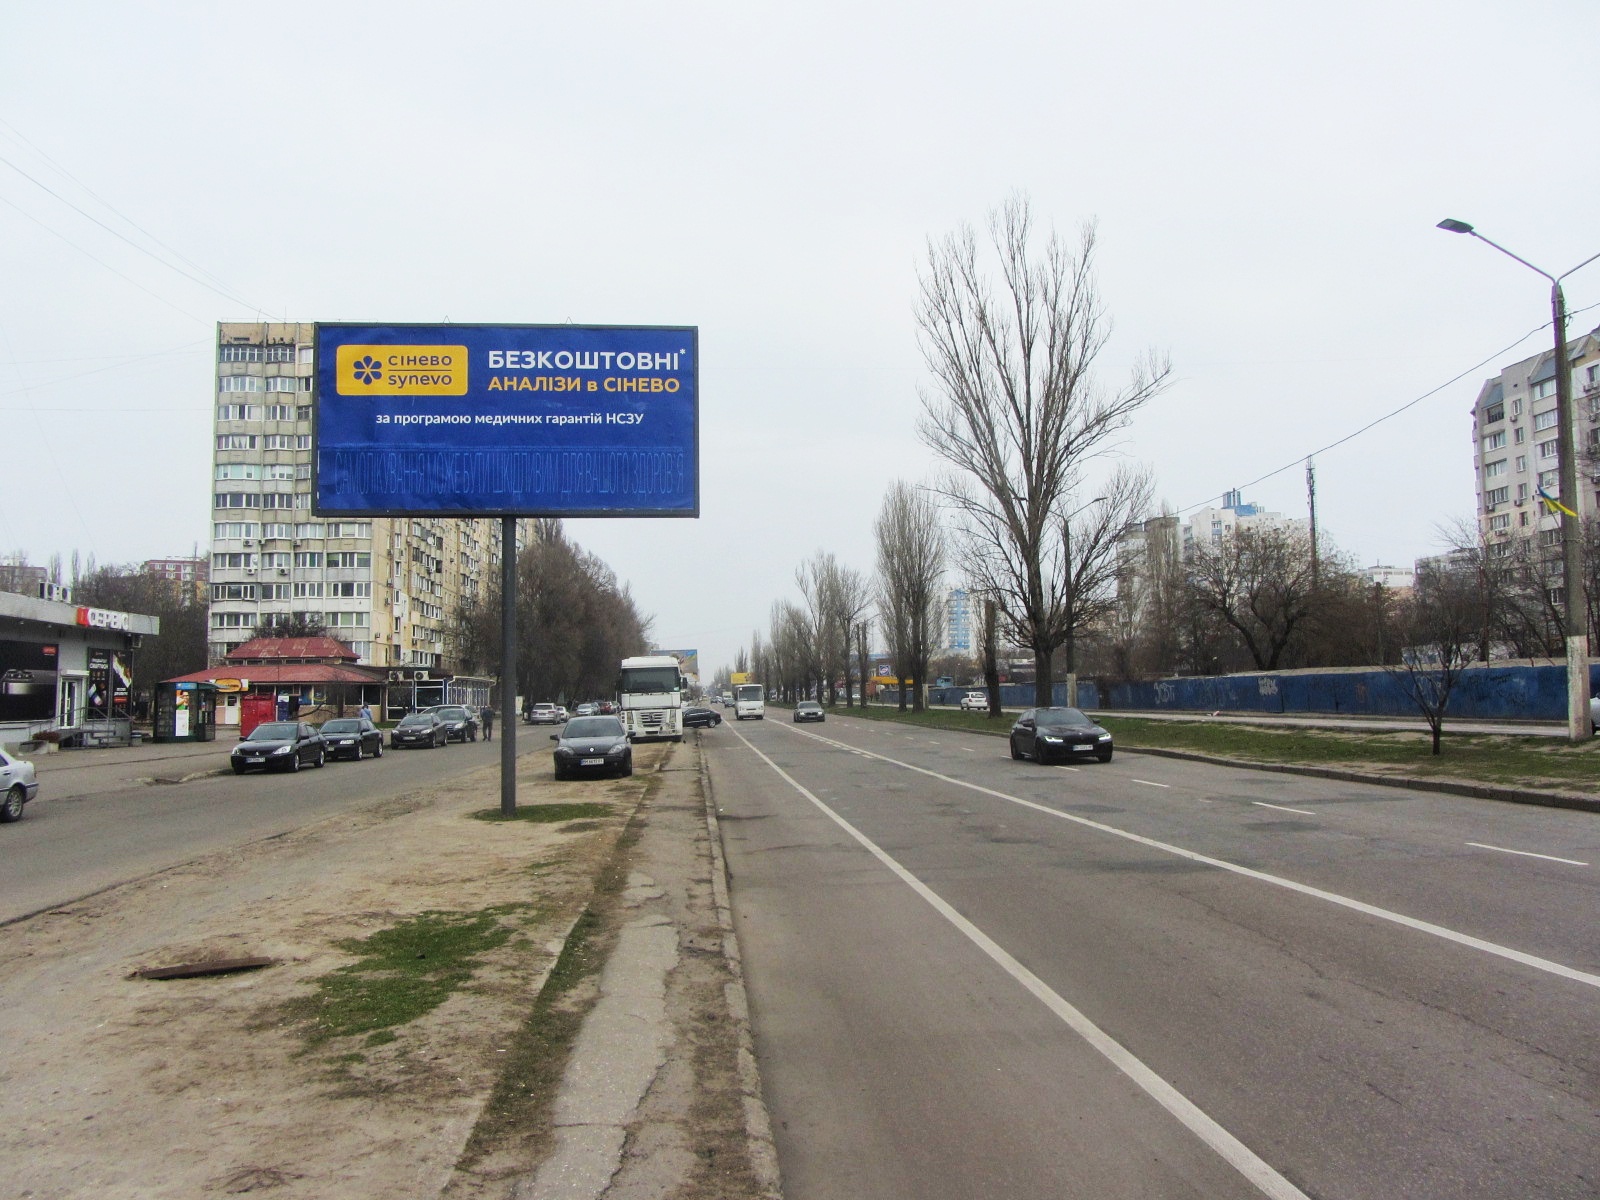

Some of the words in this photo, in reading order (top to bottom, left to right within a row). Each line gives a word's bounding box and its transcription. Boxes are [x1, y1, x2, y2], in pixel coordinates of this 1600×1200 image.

[388, 374, 453, 388] synevo
[488, 377, 581, 391] АНАЛІЗИ
[604, 378, 680, 393] СІНЕВО
[376, 415, 391, 424] за
[394, 415, 472, 427] програмою
[475, 415, 543, 425] медичних
[546, 413, 603, 426] гарантій
[606, 413, 644, 424] НСЗУ
